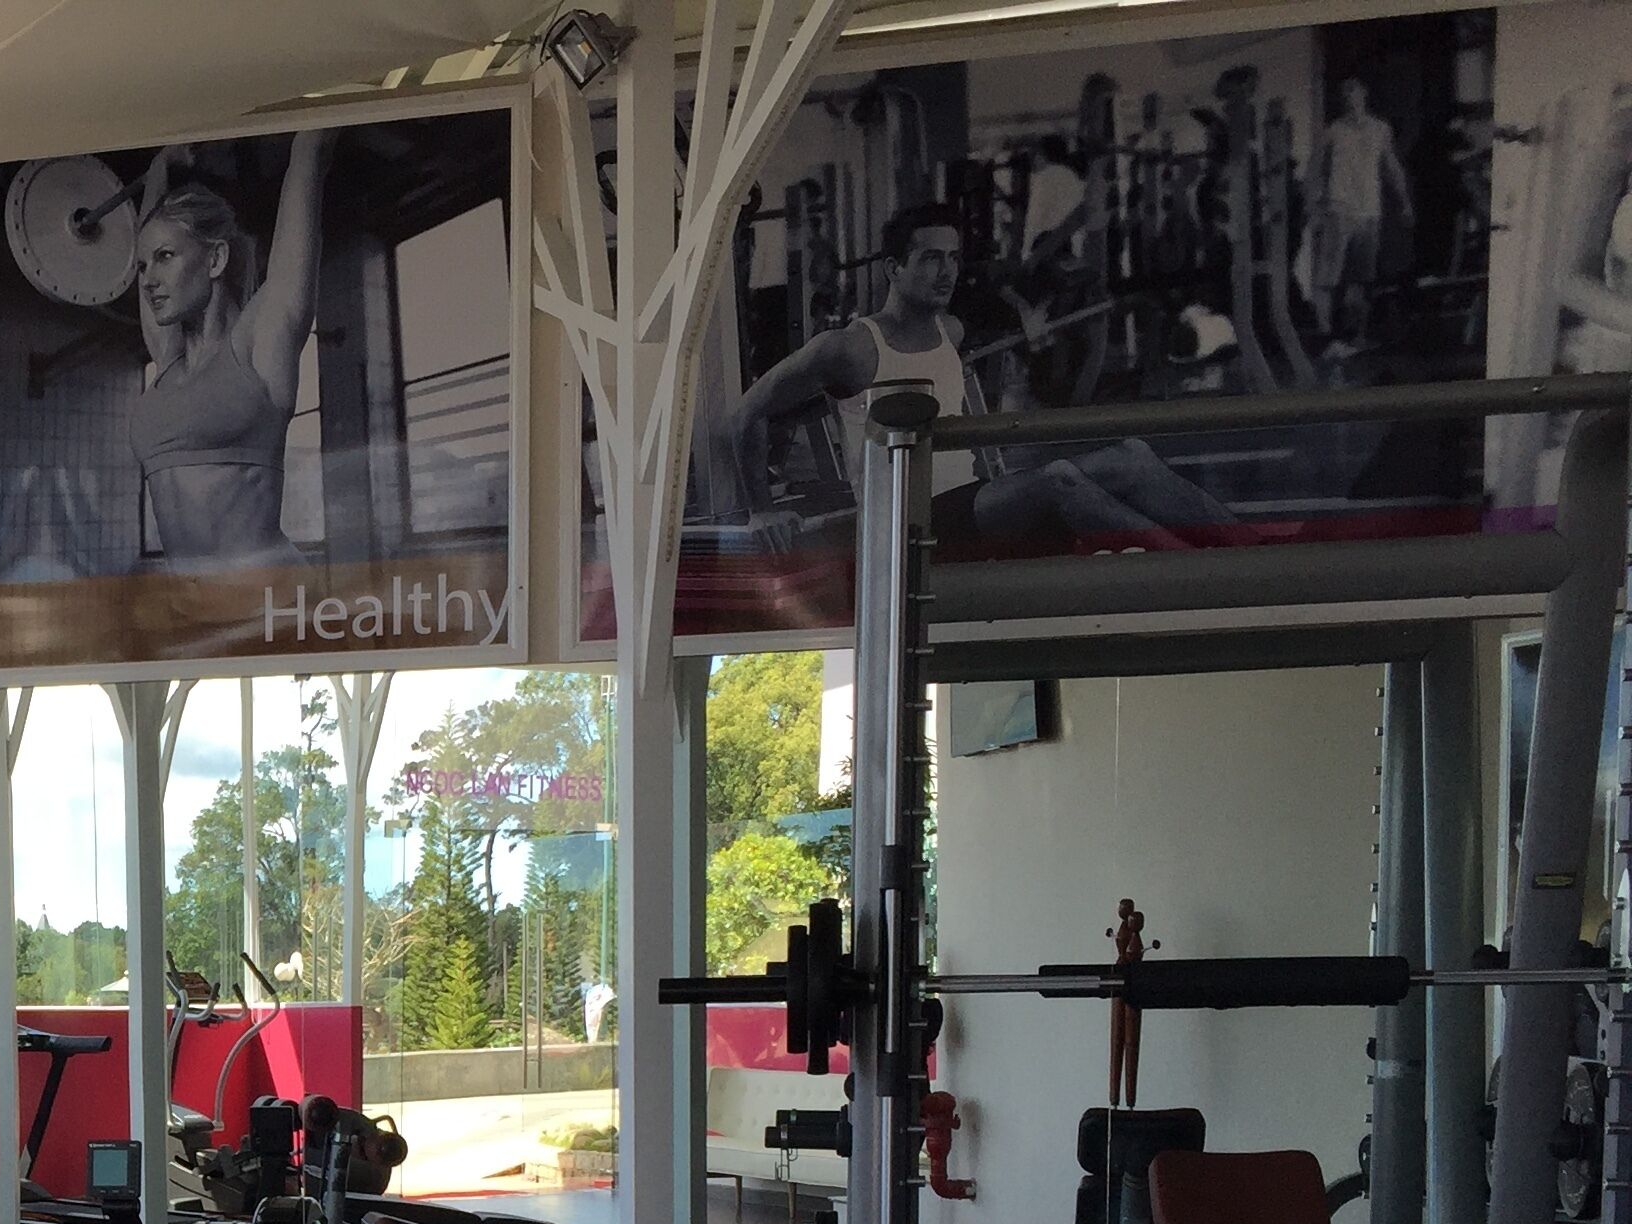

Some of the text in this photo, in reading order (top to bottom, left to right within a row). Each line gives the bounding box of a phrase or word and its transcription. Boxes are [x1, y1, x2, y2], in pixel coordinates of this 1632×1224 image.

[262, 573, 509, 646] Healthy
[472, 773, 512, 796] LAN
[518, 774, 603, 800] FITNESS
